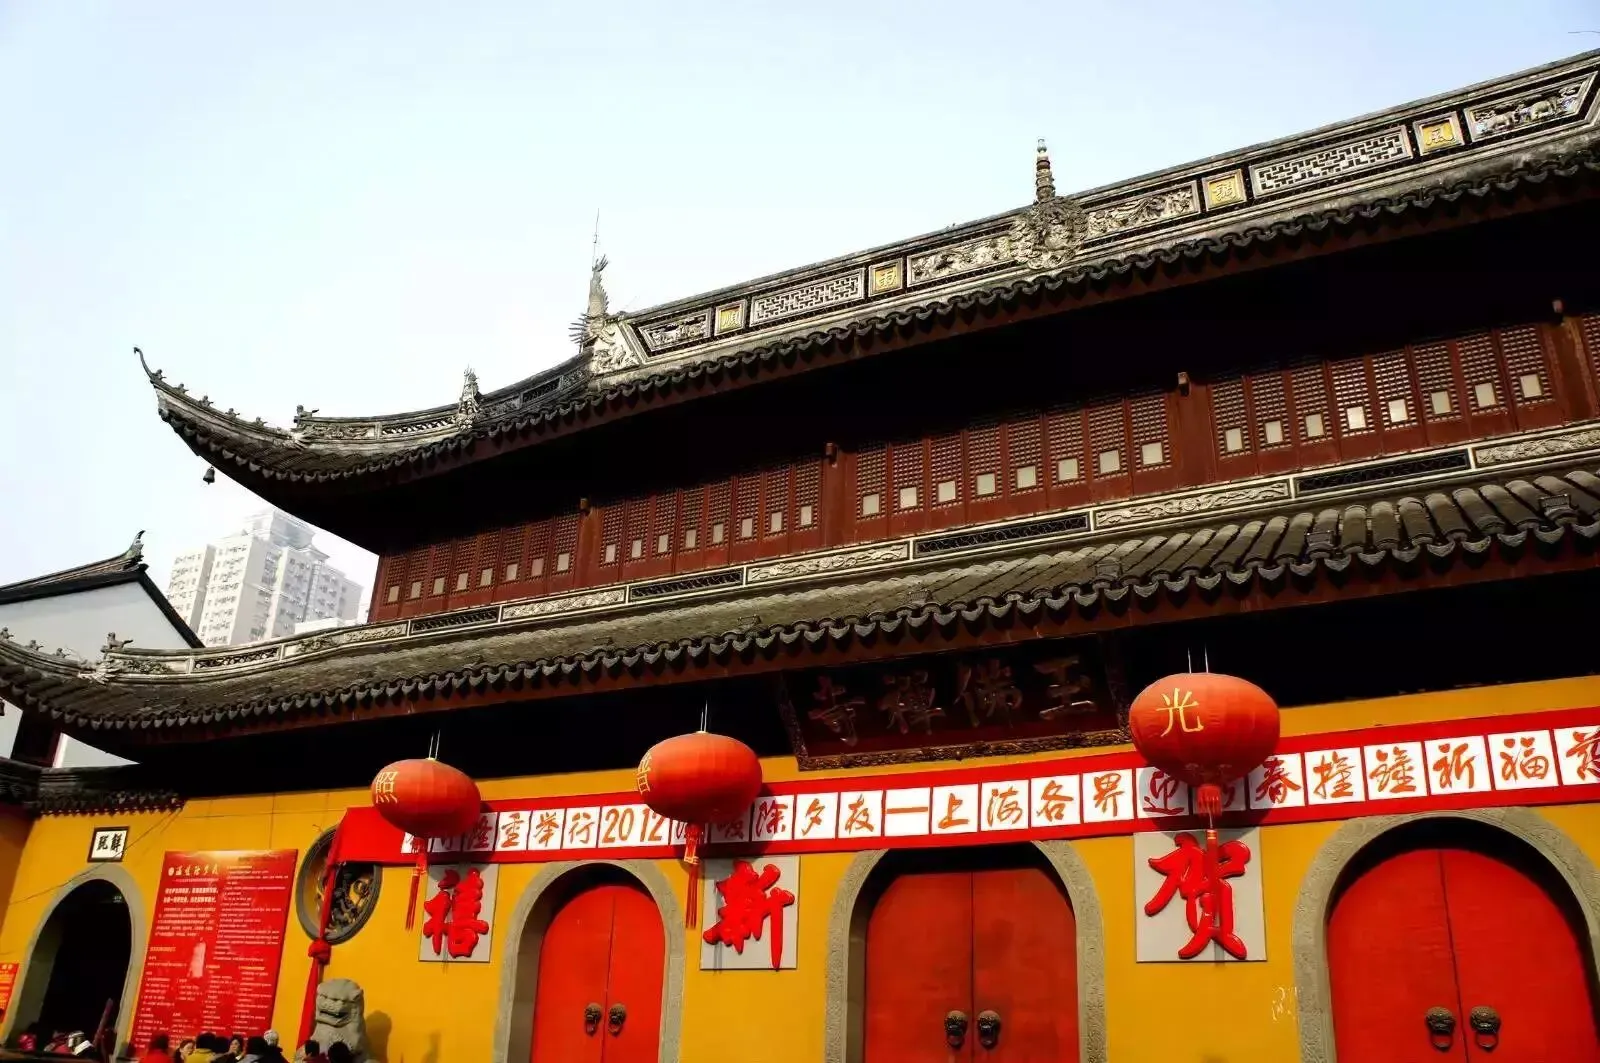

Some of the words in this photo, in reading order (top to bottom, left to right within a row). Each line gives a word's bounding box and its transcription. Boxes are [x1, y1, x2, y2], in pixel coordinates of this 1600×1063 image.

[1156, 687, 1204, 738] 光
[375, 771, 398, 804] 照
[423, 867, 489, 958] 禧
[703, 860, 795, 970] 新
[1144, 831, 1251, 960] 贺
